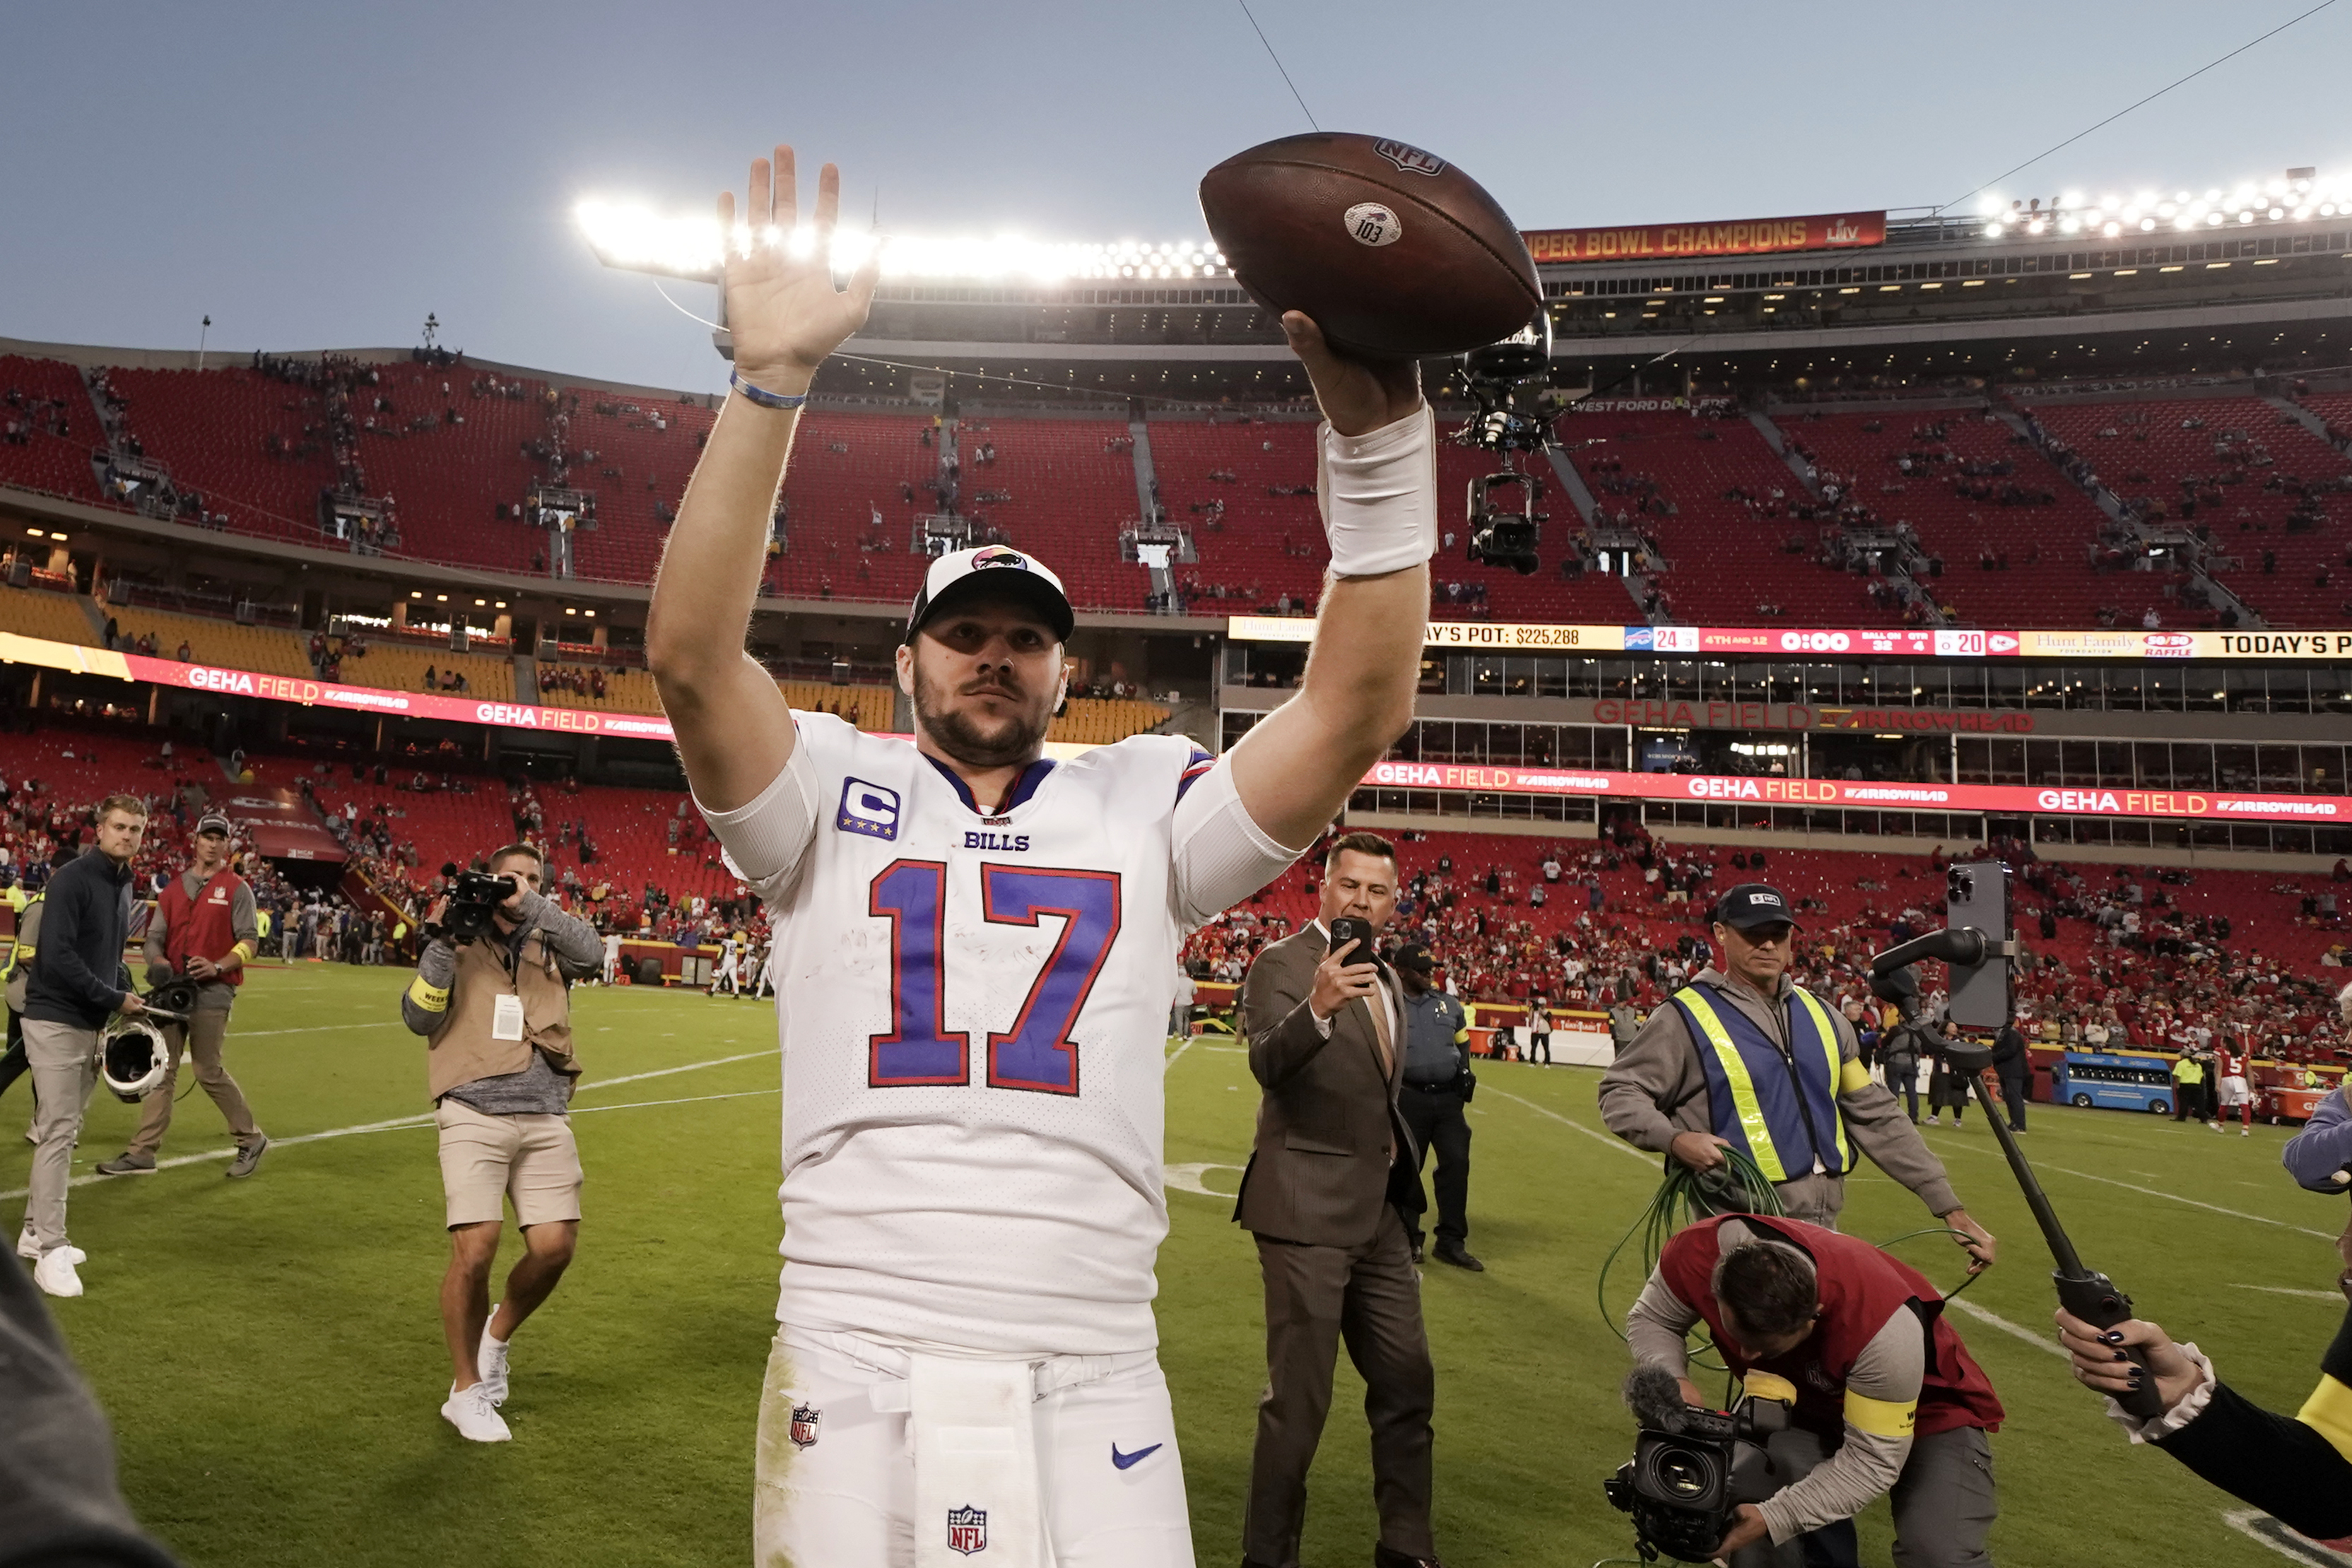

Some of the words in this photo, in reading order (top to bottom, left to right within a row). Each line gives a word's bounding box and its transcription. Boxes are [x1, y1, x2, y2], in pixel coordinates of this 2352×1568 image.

[1382, 141, 1434, 170] NFL
[1356, 219, 1383, 243] 103
[1586, 230, 1653, 257] BOWL
[1662, 221, 1807, 252] CHAMPIONS
[1616, 399, 1659, 411] FORD
[1469, 627, 1510, 643] POT:
[1517, 627, 1580, 647] $225,288
[1657, 630, 1678, 648] 24
[1705, 635, 1731, 645] 4TH
[1752, 636, 1768, 645] 12
[1781, 632, 1850, 652] 0:00
[1862, 632, 1887, 640] BALL
[1872, 639, 1893, 651] 32
[1912, 640, 1925, 652] 4
[1958, 634, 1982, 652] 20
[2036, 634, 2076, 647] Hunt
[2083, 634, 2135, 652] Family
[2147, 635, 2190, 646] 50/50
[2221, 636, 2327, 654] TODAY'S
[188, 668, 253, 693] GEHA
[258, 677, 319, 700] FIELD
[476, 704, 536, 726] GEHA
[541, 710, 599, 731] FIELD
[1593, 698, 1698, 726] GEHA
[1707, 702, 1813, 730] FIELD
[1840, 710, 2035, 732] ARROWHEAD
[1377, 765, 1442, 786] GEHA
[1447, 768, 1510, 787] FIELD
[1688, 777, 1760, 798] GEHA
[1767, 781, 1837, 801] FIELD
[1854, 788, 1948, 802] ARROWHEAD
[846, 782, 897, 825] C
[2038, 790, 2120, 812] GEHA
[2127, 794, 2208, 814] FIELD
[2228, 800, 2336, 815] ARROWHEAD
[964, 831, 1030, 851] BILLS
[869, 858, 1122, 1098] 17
[2228, 1056, 2243, 1074] 5
[792, 1422, 813, 1442] NFL
[951, 1526, 983, 1552] NFL
